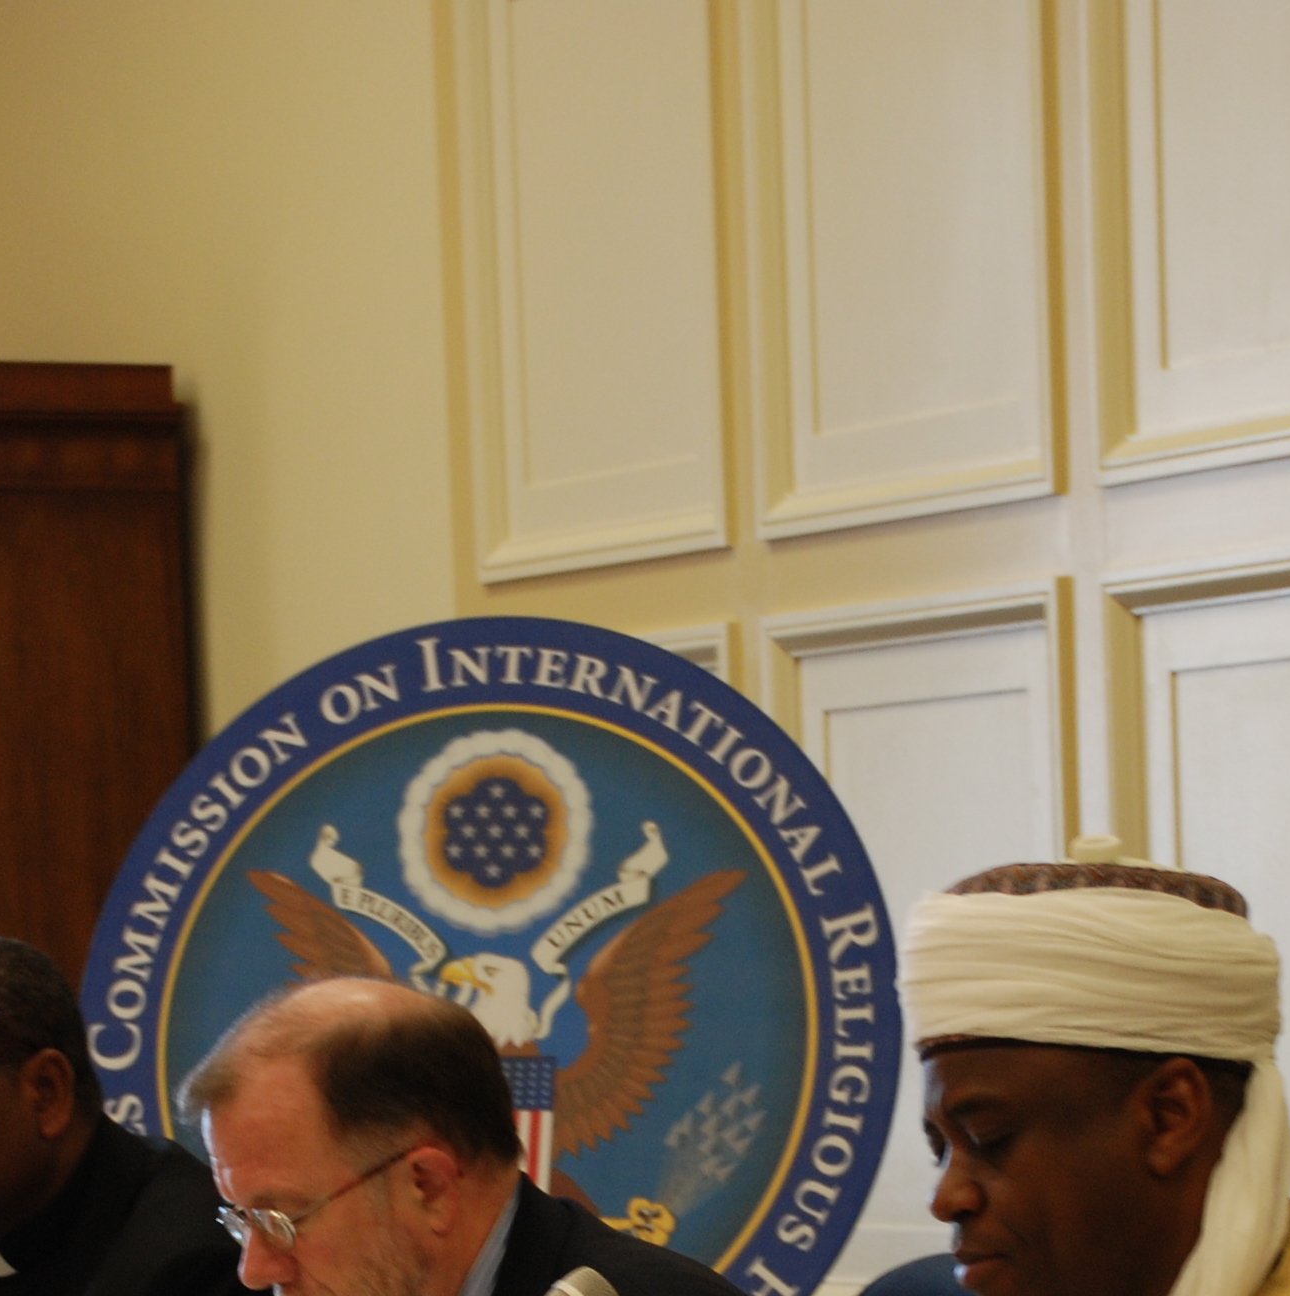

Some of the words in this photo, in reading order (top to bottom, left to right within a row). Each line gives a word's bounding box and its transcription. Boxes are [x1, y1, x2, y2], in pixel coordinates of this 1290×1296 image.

[88, 712, 309, 1070] COMMISSION
[319, 664, 401, 725] ON
[415, 637, 843, 896] INTERNATIONAL
[775, 904, 880, 1252] RELIGIOUS
[546, 890, 625, 949] UNUM
